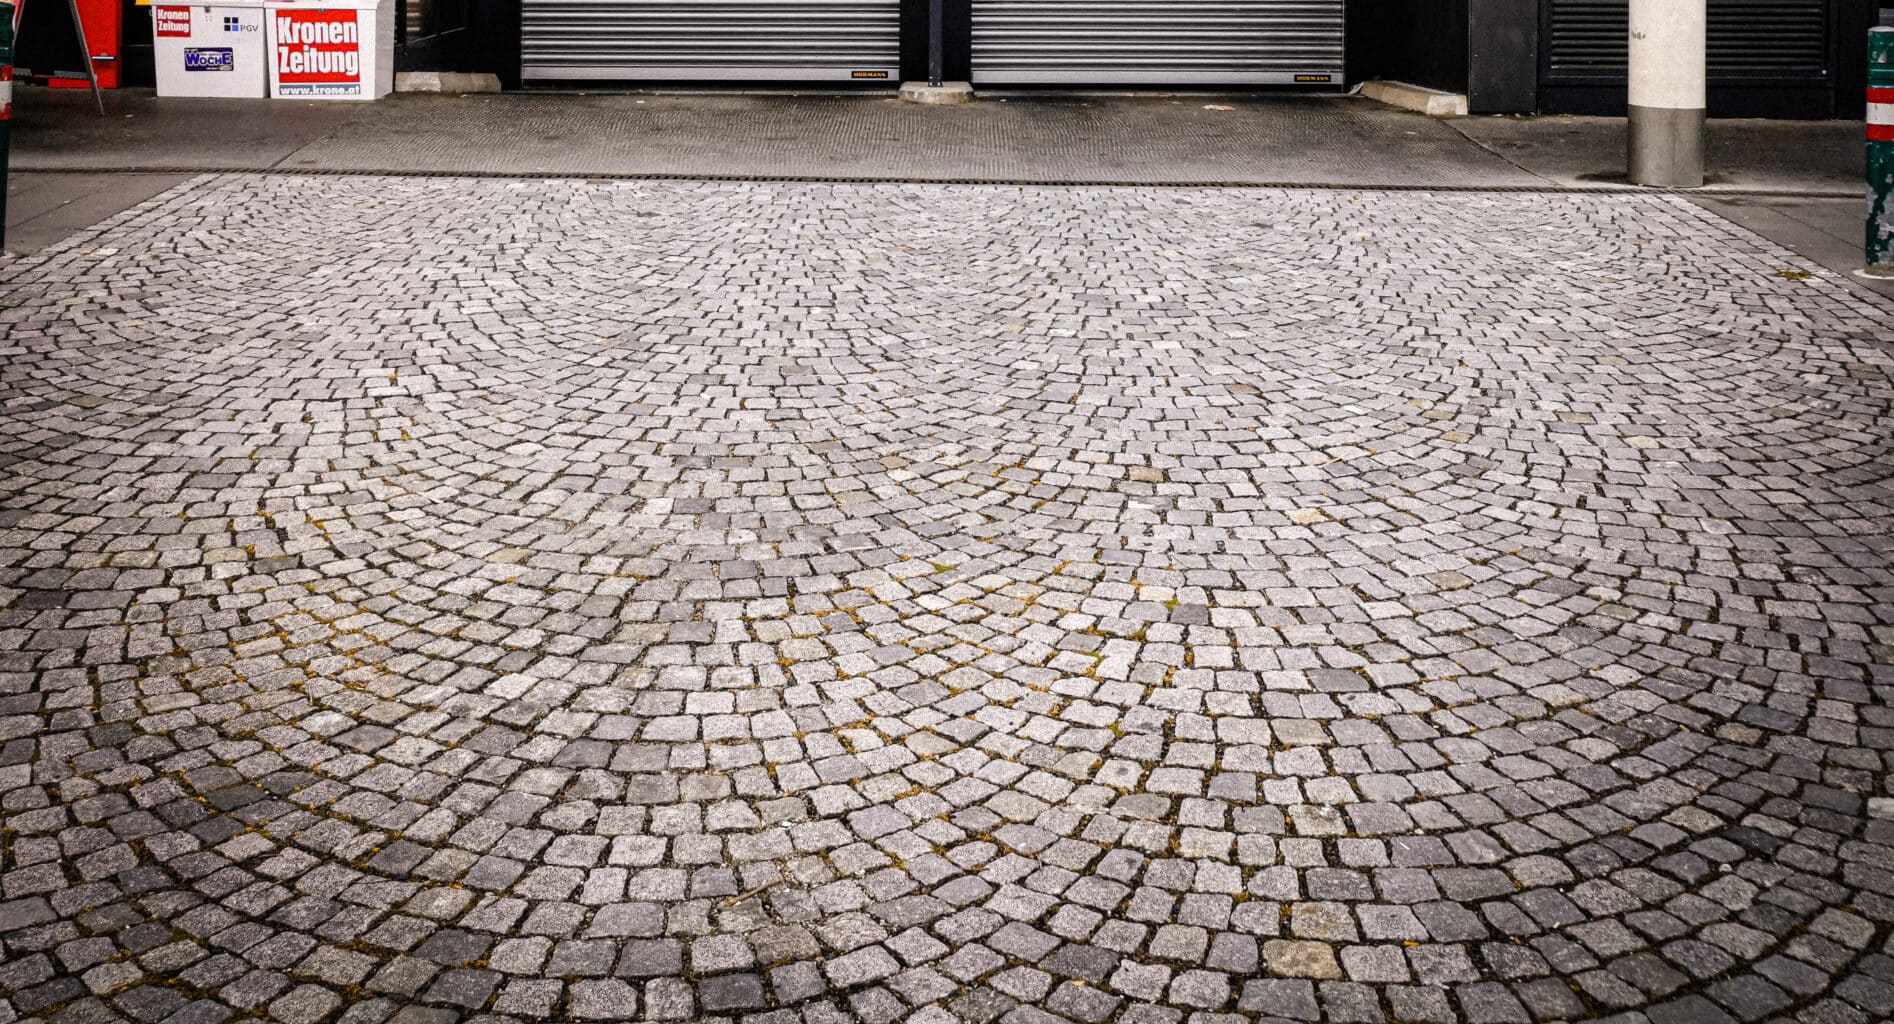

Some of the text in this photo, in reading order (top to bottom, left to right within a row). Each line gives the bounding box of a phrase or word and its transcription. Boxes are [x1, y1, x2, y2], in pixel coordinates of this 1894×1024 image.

[157, 9, 190, 20] Kronen
[158, 20, 190, 33] Zeitung
[240, 24, 259, 32] PGV
[277, 16, 358, 45] Kronen
[278, 44, 360, 77] Zeitung
[279, 84, 361, 95] www.krone.at
